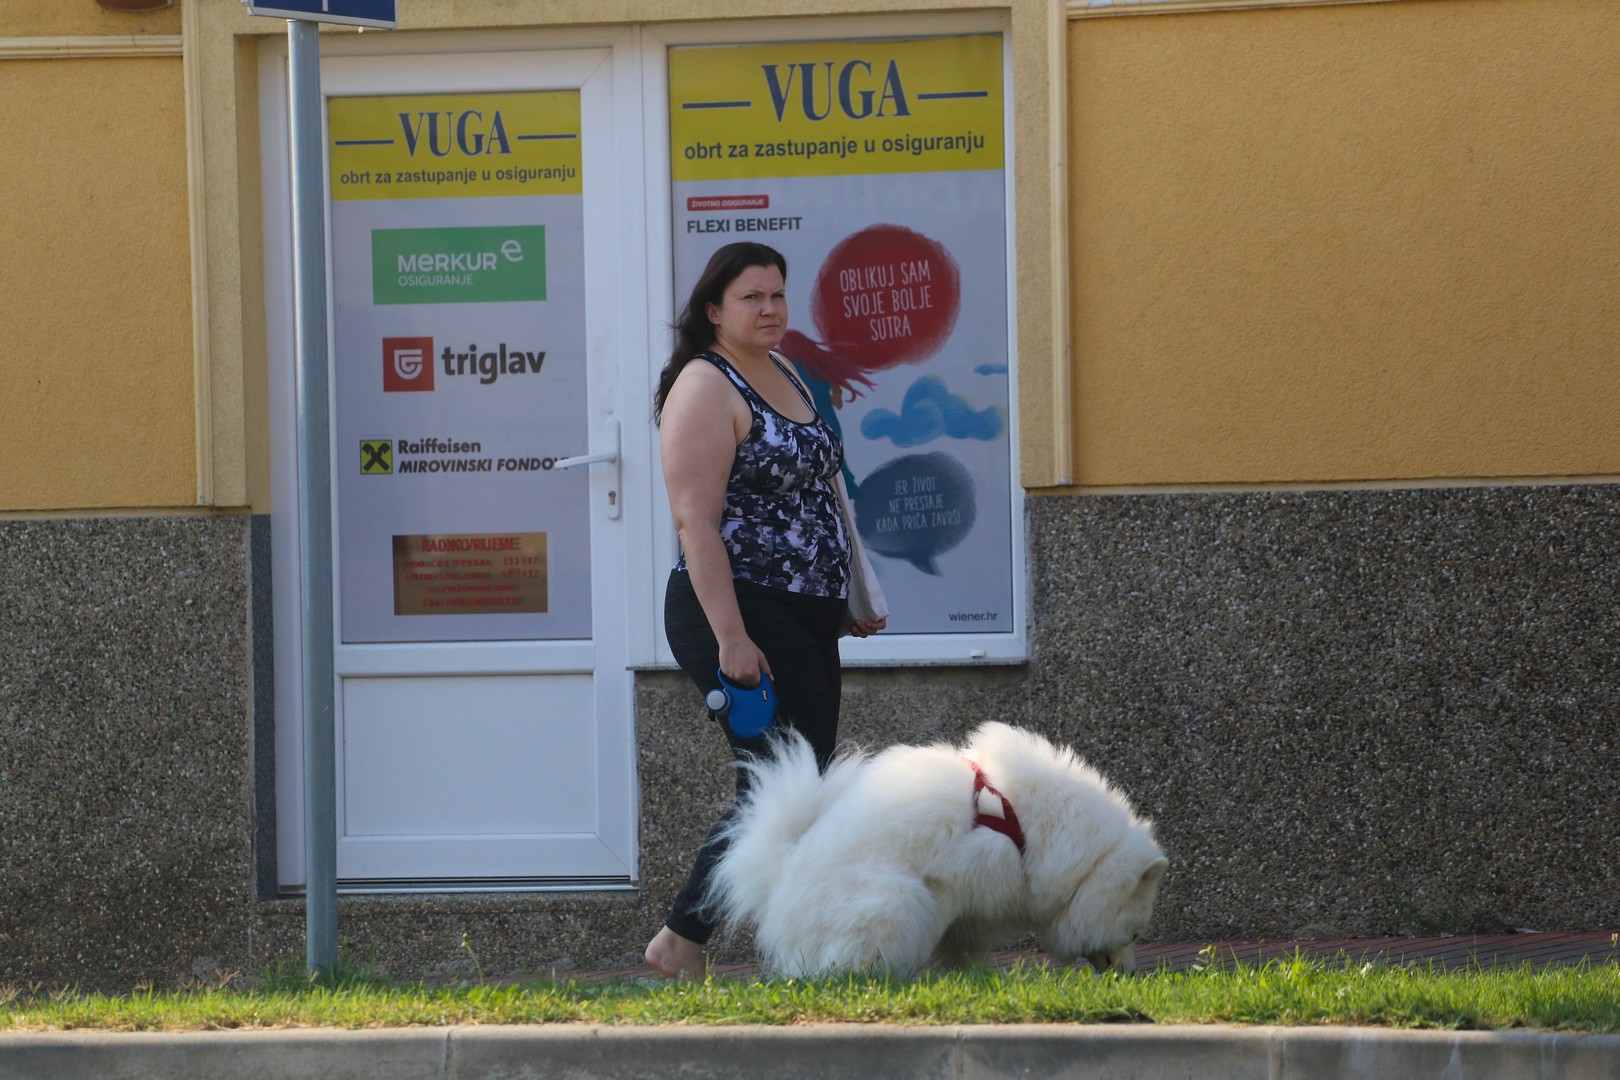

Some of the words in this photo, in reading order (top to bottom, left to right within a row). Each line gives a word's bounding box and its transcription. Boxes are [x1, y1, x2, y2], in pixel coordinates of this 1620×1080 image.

[760, 59, 911, 123] VUGA
[397, 109, 512, 158] VUGA
[684, 139, 723, 160] obrt
[728, 143, 749, 159] za
[754, 136, 858, 160] zastupanje
[864, 140, 876, 154] u
[882, 131, 985, 156] osiguranju
[340, 167, 371, 185] obrt
[375, 172, 392, 184] za
[396, 168, 477, 186] zastupanje
[481, 170, 491, 182] u
[495, 164, 576, 183] osiguranju
[686, 219, 730, 234] FLEXI
[735, 216, 803, 232] BENEFIT
[398, 273, 474, 287] OSIGURANJE
[839, 263, 895, 293] OBLIKUJ
[899, 259, 931, 285] SAM
[843, 291, 886, 319] SVOJE
[892, 285, 933, 313] BOLJE
[869, 314, 913, 342] SUTRA
[441, 343, 547, 385] triglav
[397, 438, 482, 455] Raiffeisen
[398, 458, 493, 474] MIROVINSKI
[888, 498, 901, 514] NE
[904, 493, 944, 512] PRESTAJE
[876, 517, 900, 533] KADA
[948, 610, 999, 622] wiener.hr
